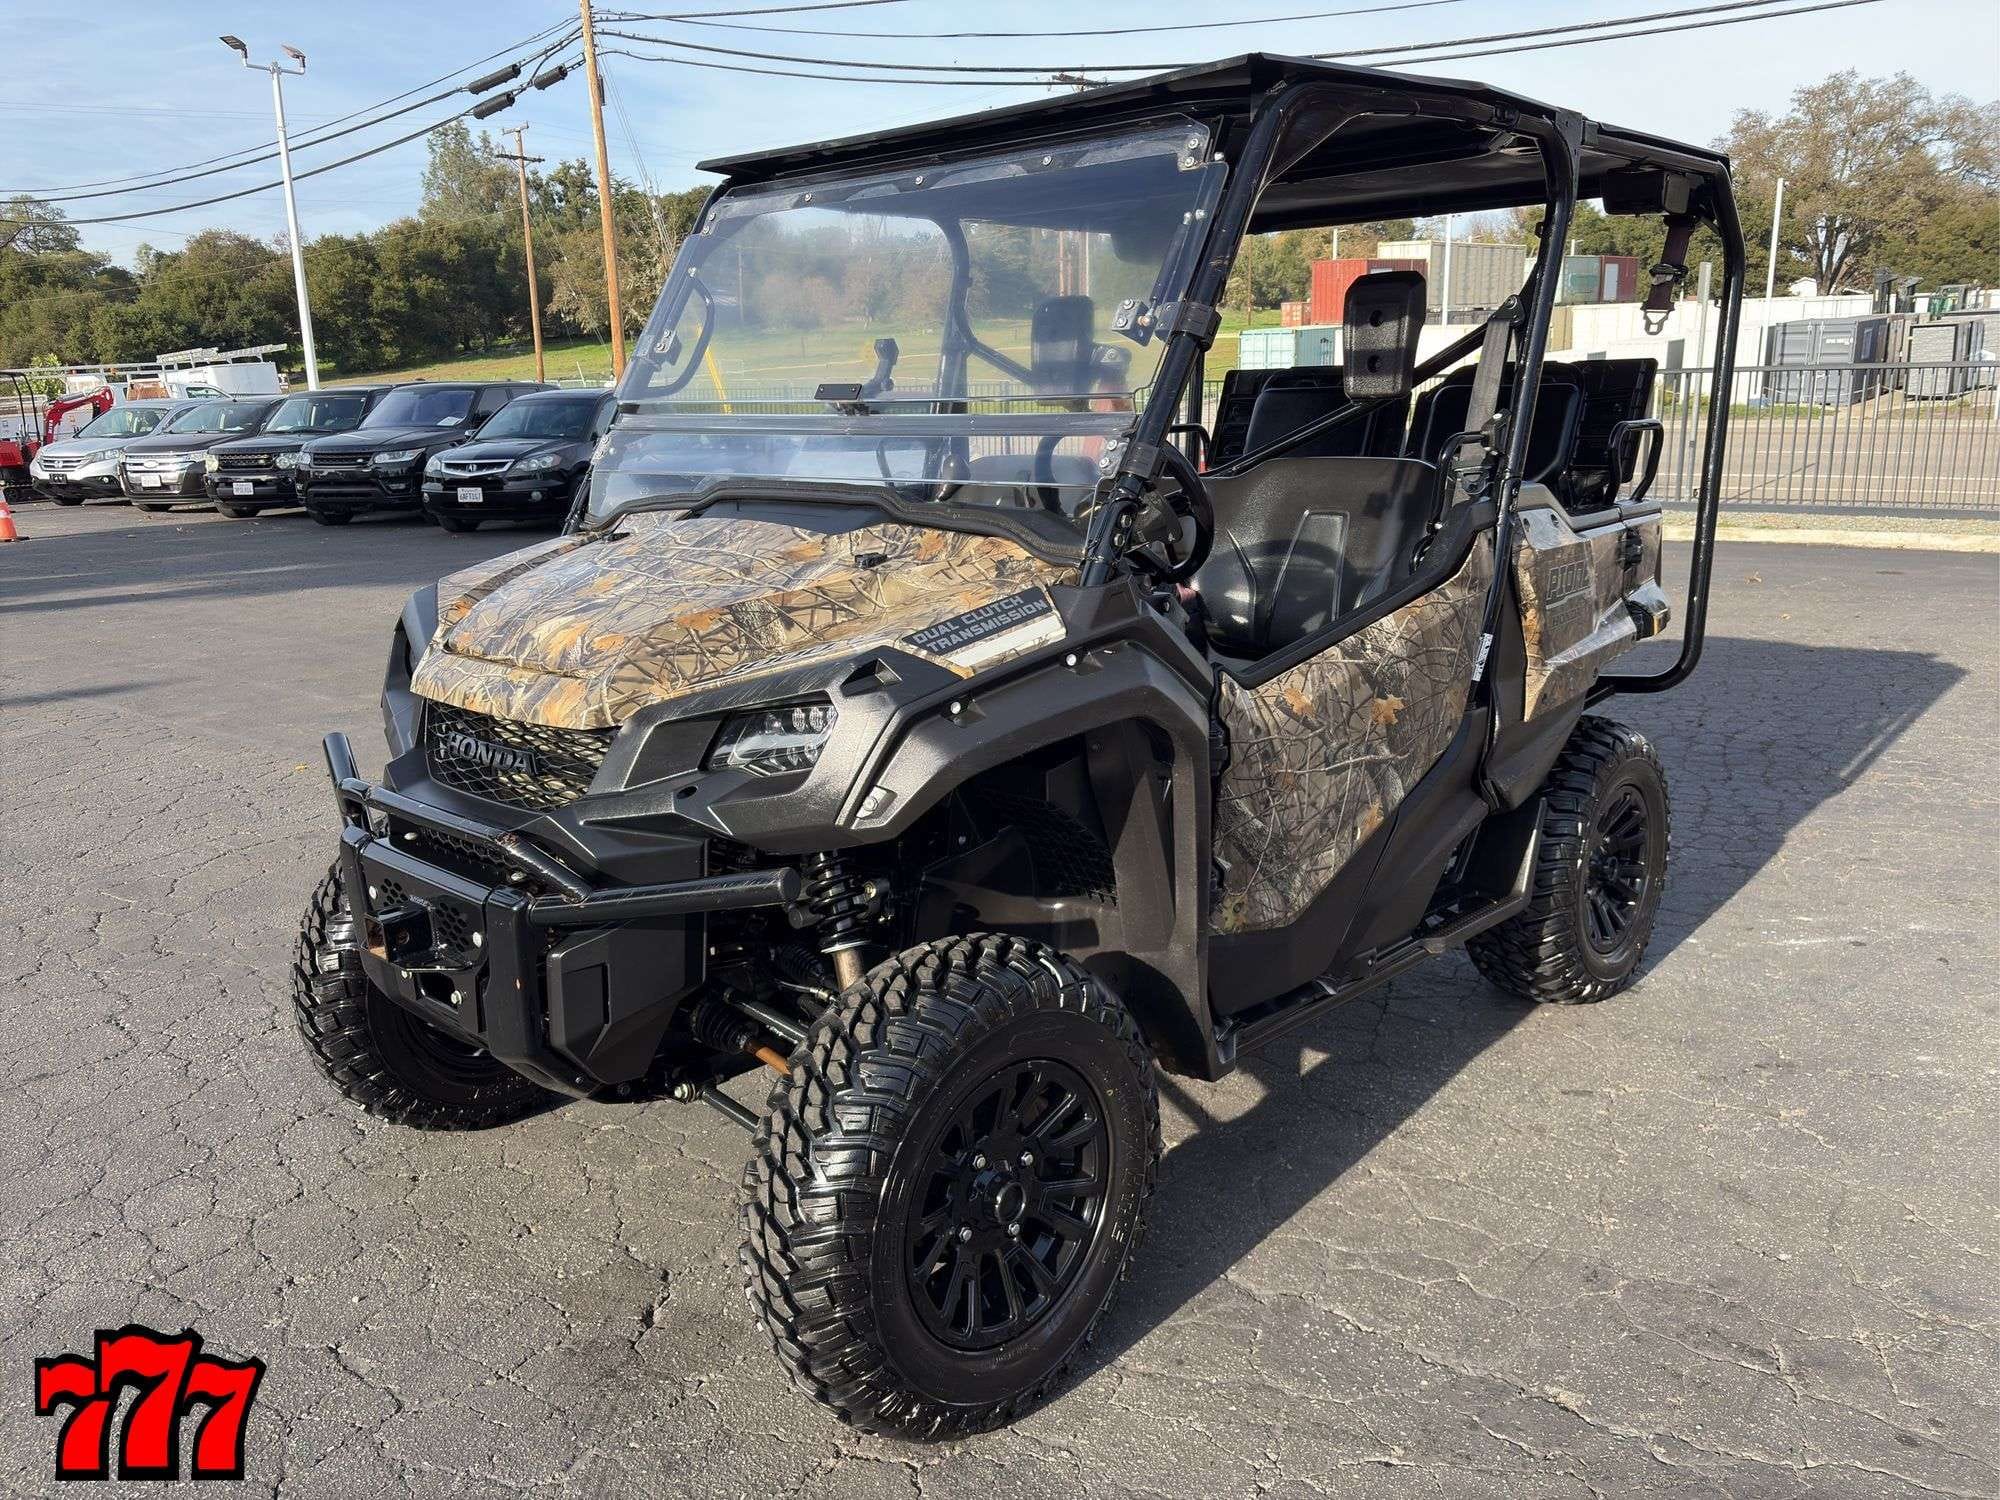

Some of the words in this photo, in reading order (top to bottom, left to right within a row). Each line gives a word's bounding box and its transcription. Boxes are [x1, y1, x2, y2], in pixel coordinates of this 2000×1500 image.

[914, 623, 960, 643] DUAL
[962, 595, 1024, 624] CLUTCH
[926, 599, 1048, 653] TRANSMISSION
[447, 733, 533, 773] HONDA
